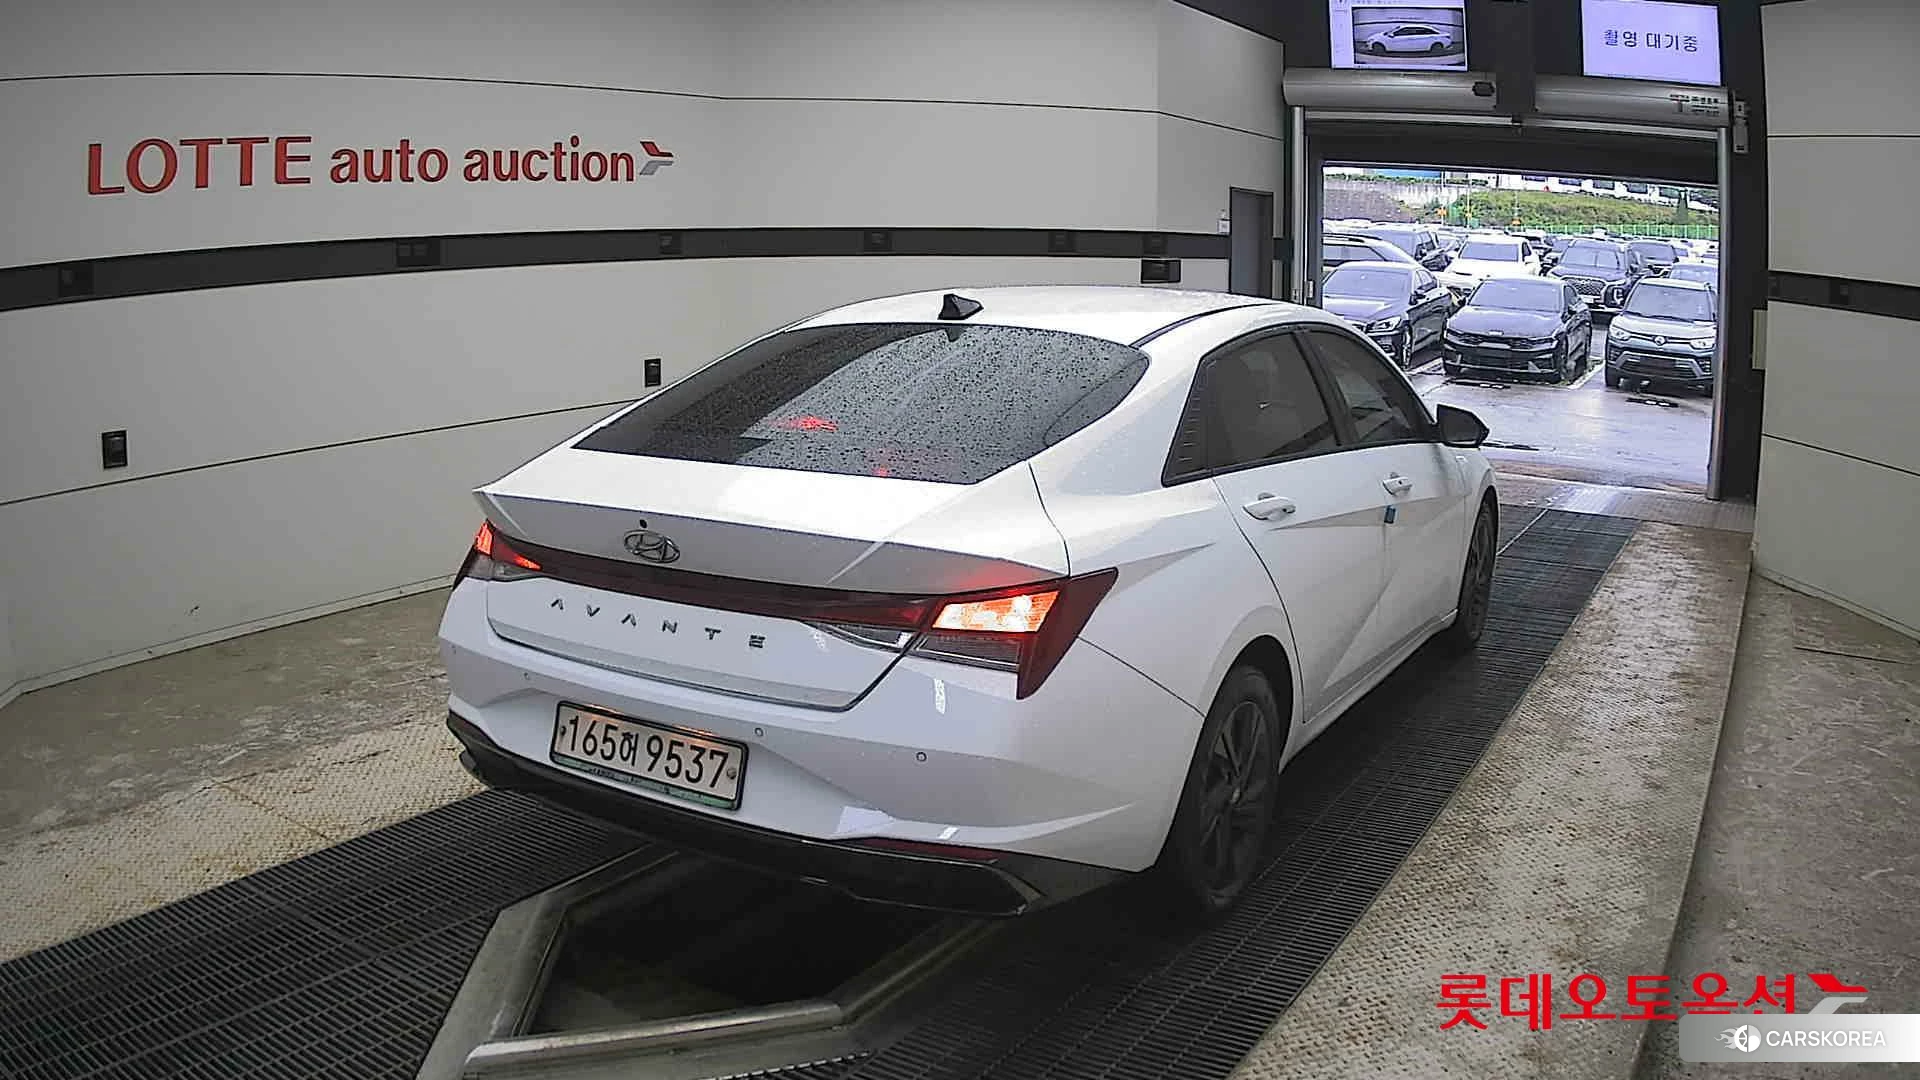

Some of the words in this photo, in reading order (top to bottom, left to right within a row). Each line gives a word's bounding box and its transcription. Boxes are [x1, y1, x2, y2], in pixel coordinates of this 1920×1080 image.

[87, 136, 312, 195] LOTTE
[330, 139, 449, 183] auto
[463, 135, 634, 182] auction
[551, 598, 766, 649] AVANTE
[569, 715, 638, 767] 165허
[646, 735, 729, 788] 9537
